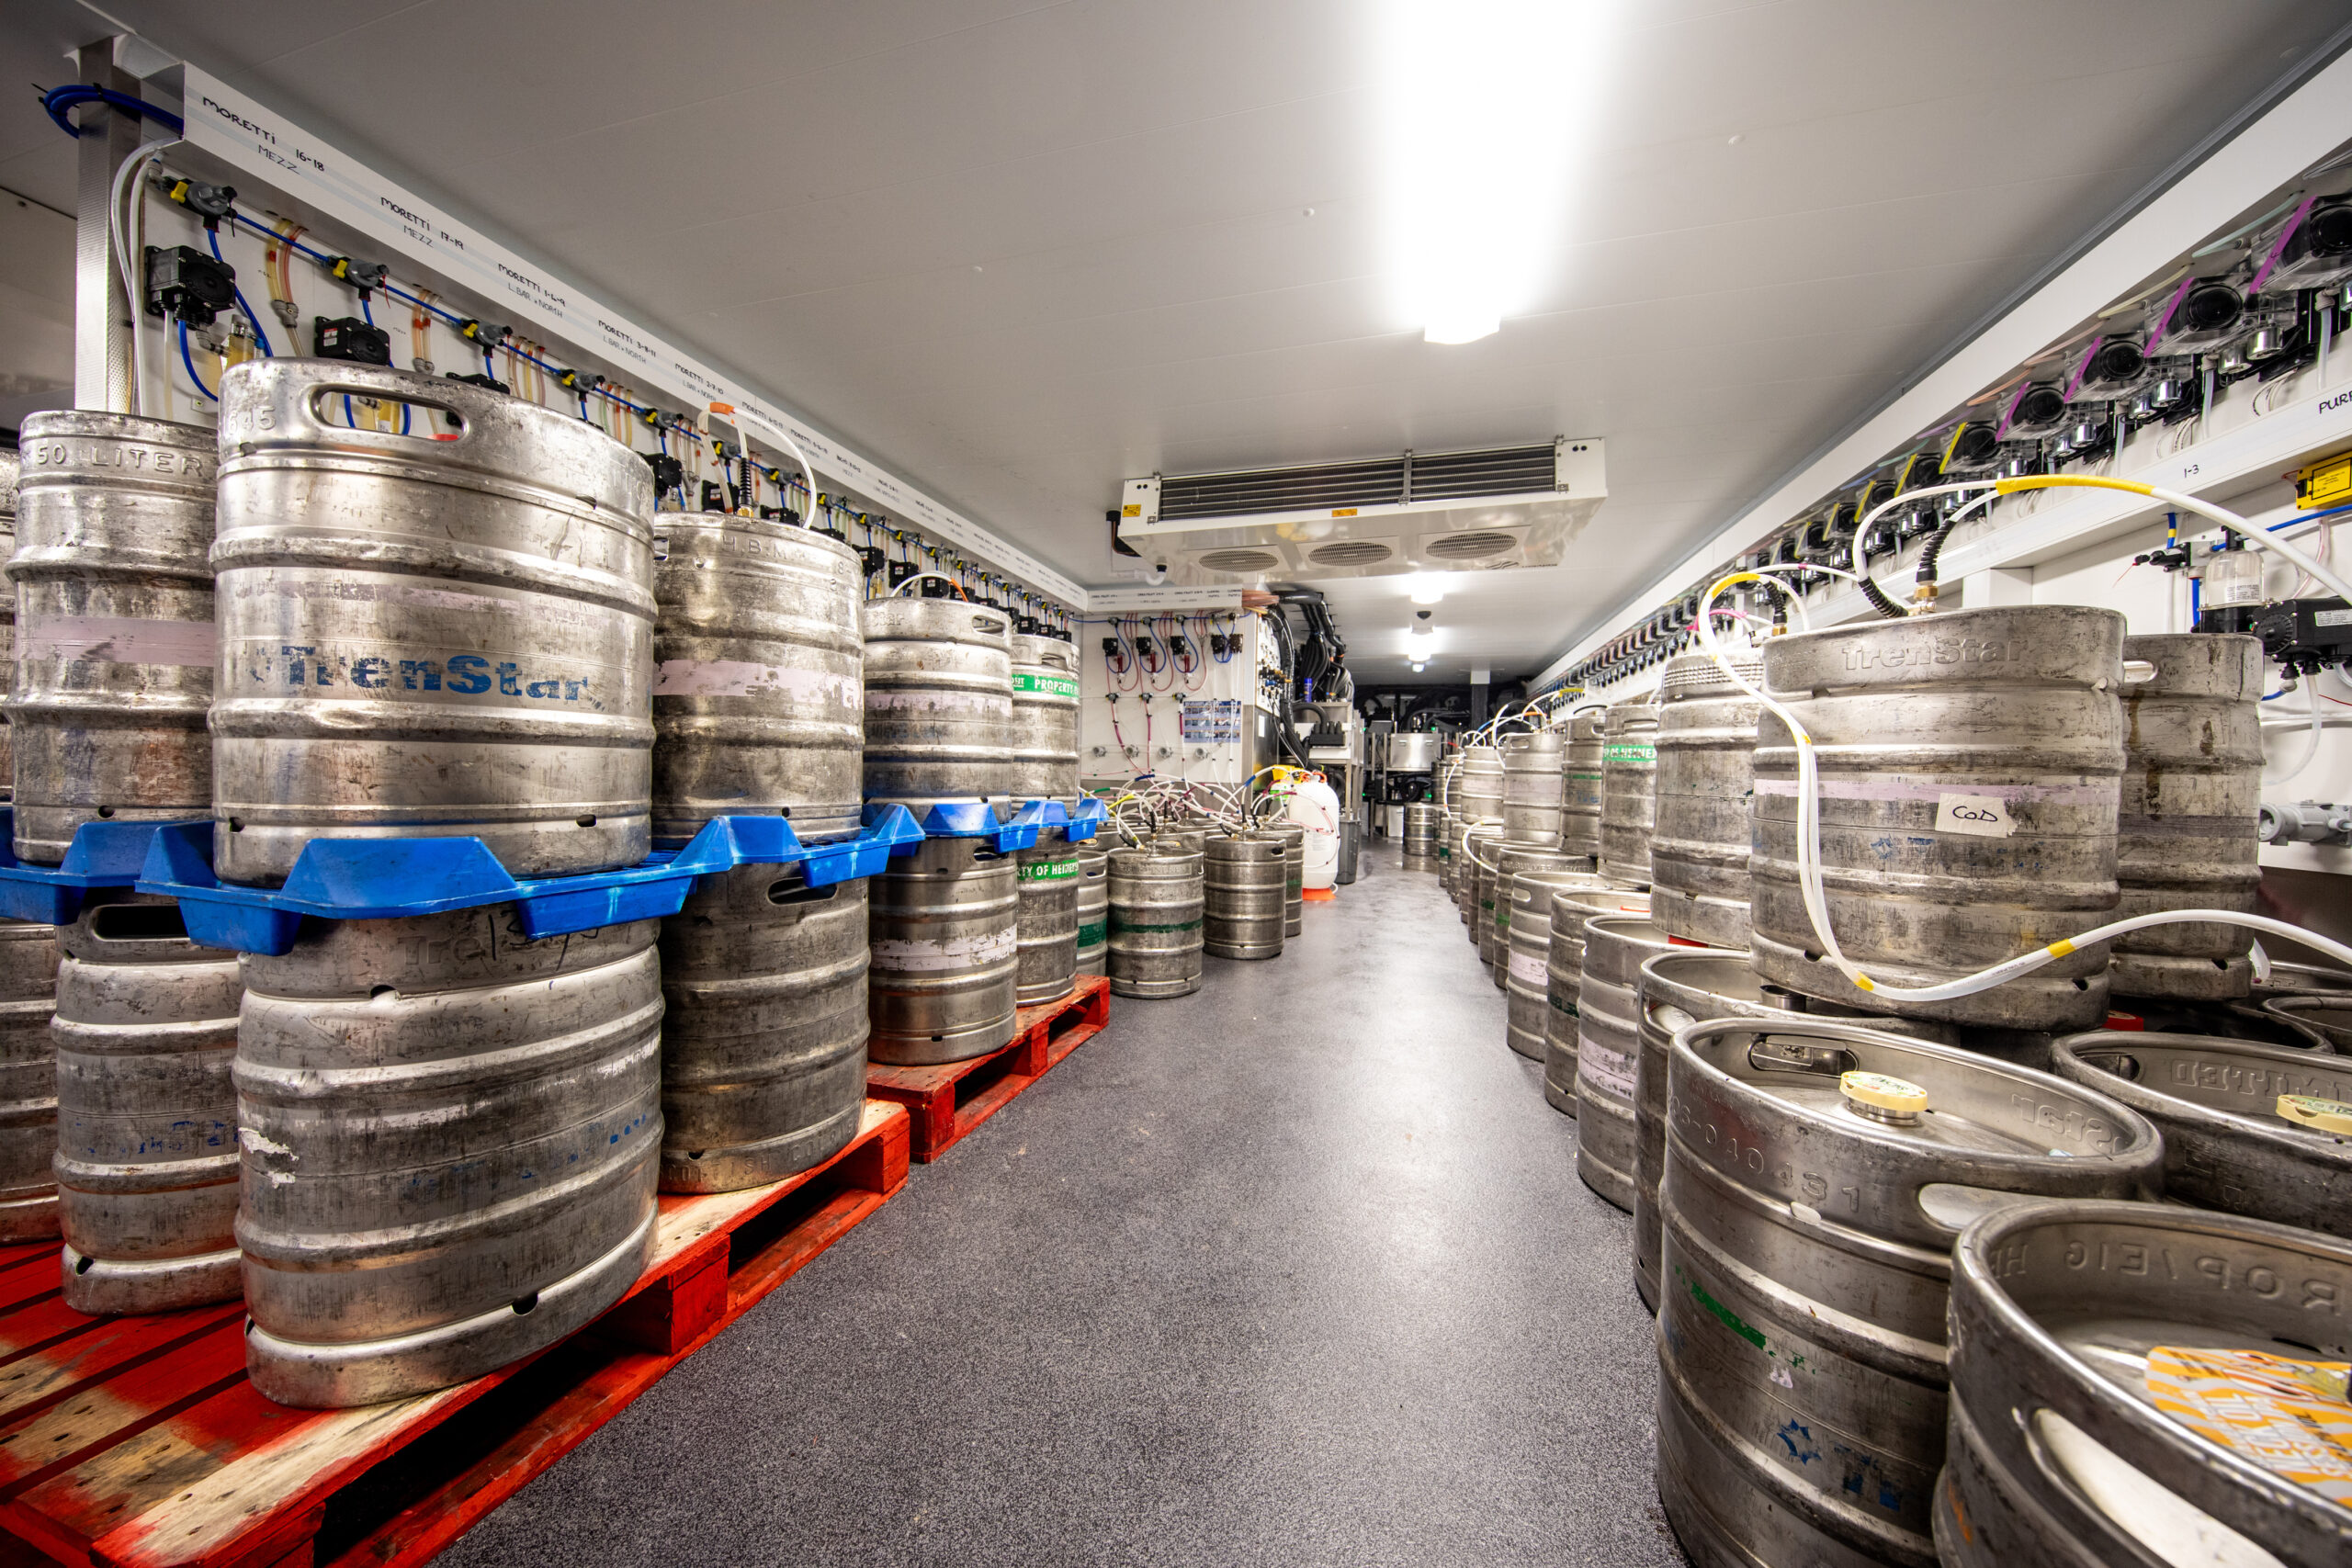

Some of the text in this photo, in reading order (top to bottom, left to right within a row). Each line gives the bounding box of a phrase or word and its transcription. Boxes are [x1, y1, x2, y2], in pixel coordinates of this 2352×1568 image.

[258, 144, 300, 175] MEZZ
[296, 149, 325, 172] 16-18
[404, 225, 434, 248] MEZZ
[37, 444, 204, 477] 50 LITER
[2184, 464, 2199, 478] 1-3
[1840, 637, 2031, 671] TrenStar
[1035, 864, 1049, 876] OF
[2203, 1393, 2263, 1422] OIL
